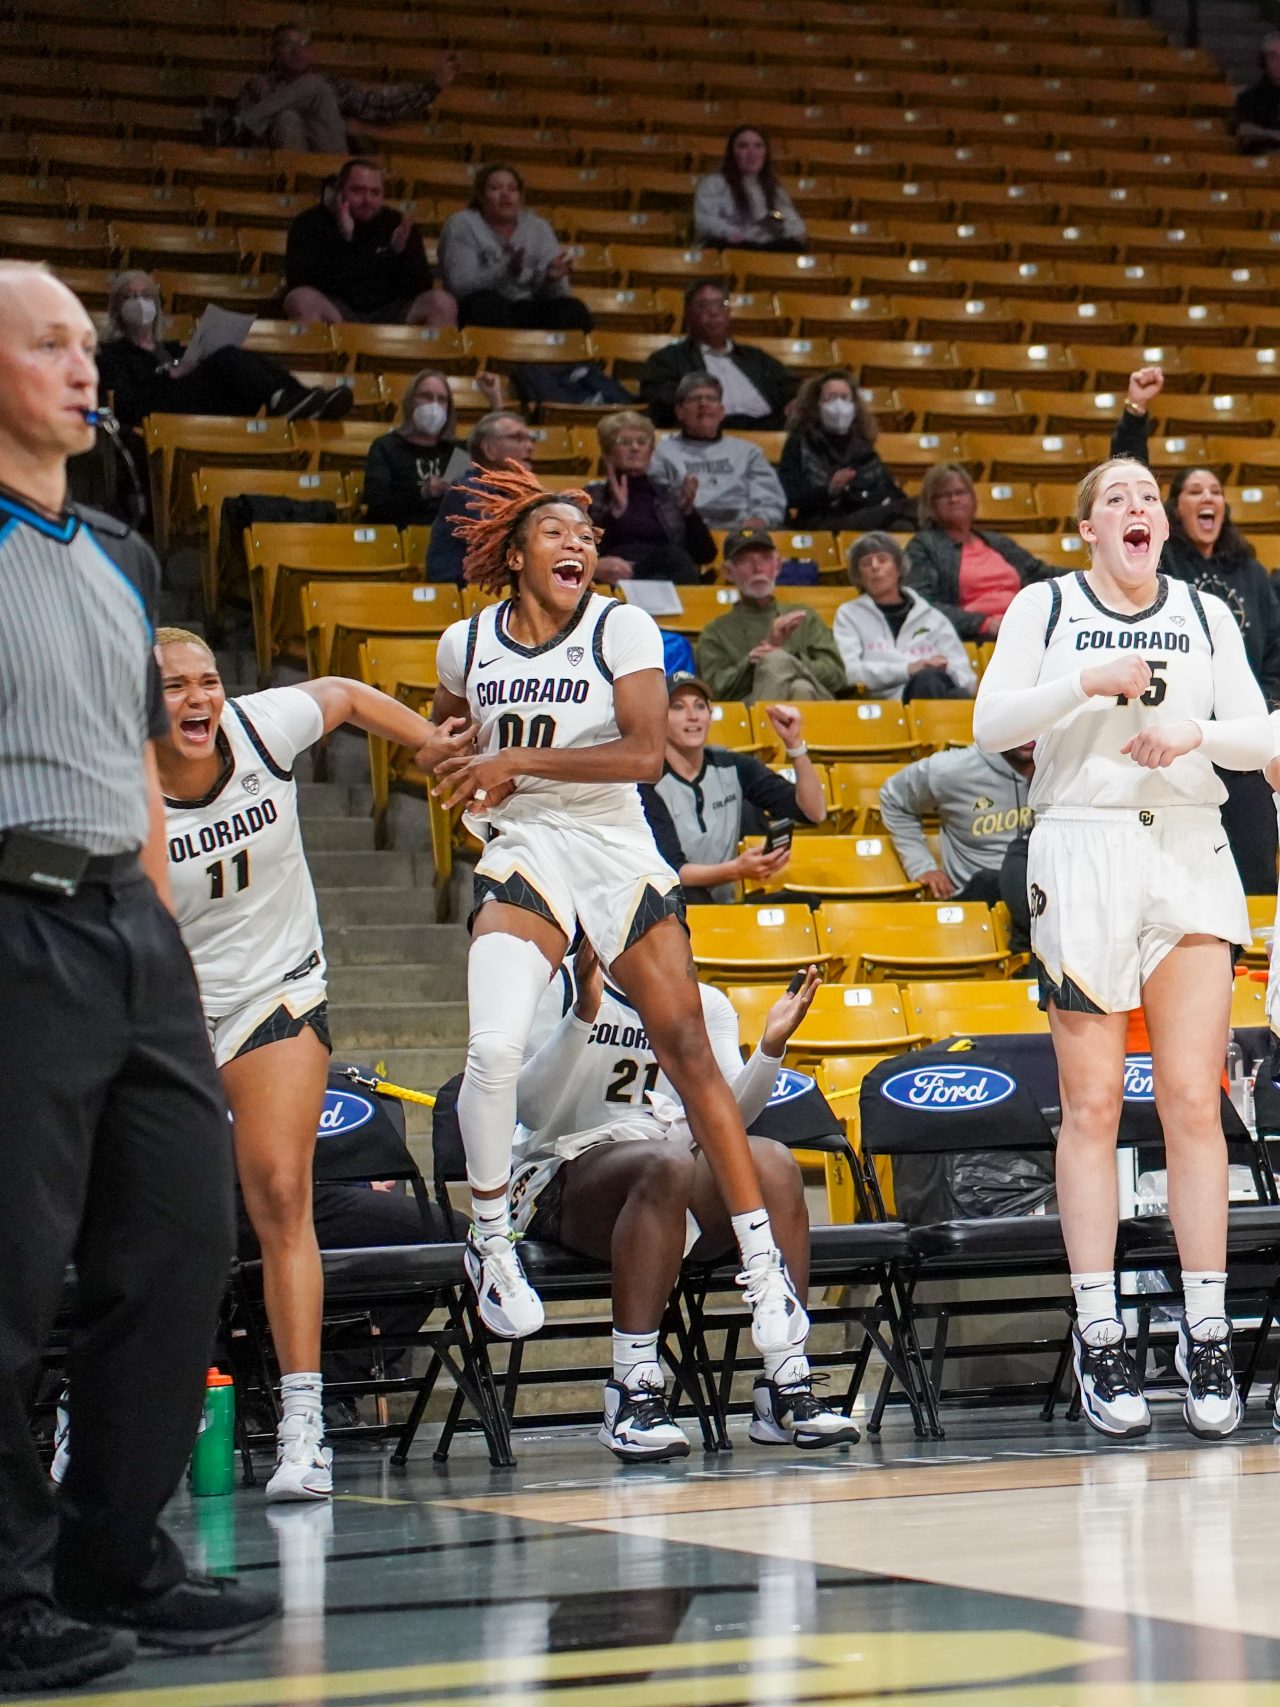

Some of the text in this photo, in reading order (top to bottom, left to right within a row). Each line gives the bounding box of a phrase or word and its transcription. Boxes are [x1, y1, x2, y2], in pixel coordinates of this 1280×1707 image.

[1075, 630, 1190, 653] COLORADO
[476, 678, 590, 708] COLORADO
[168, 798, 278, 864] OLORADO
[971, 806, 1035, 838] COLOR
[205, 848, 250, 900] 11
[587, 1023, 651, 1051] COLOR
[605, 1058, 661, 1105] 21
[908, 1071, 989, 1105] Ford
